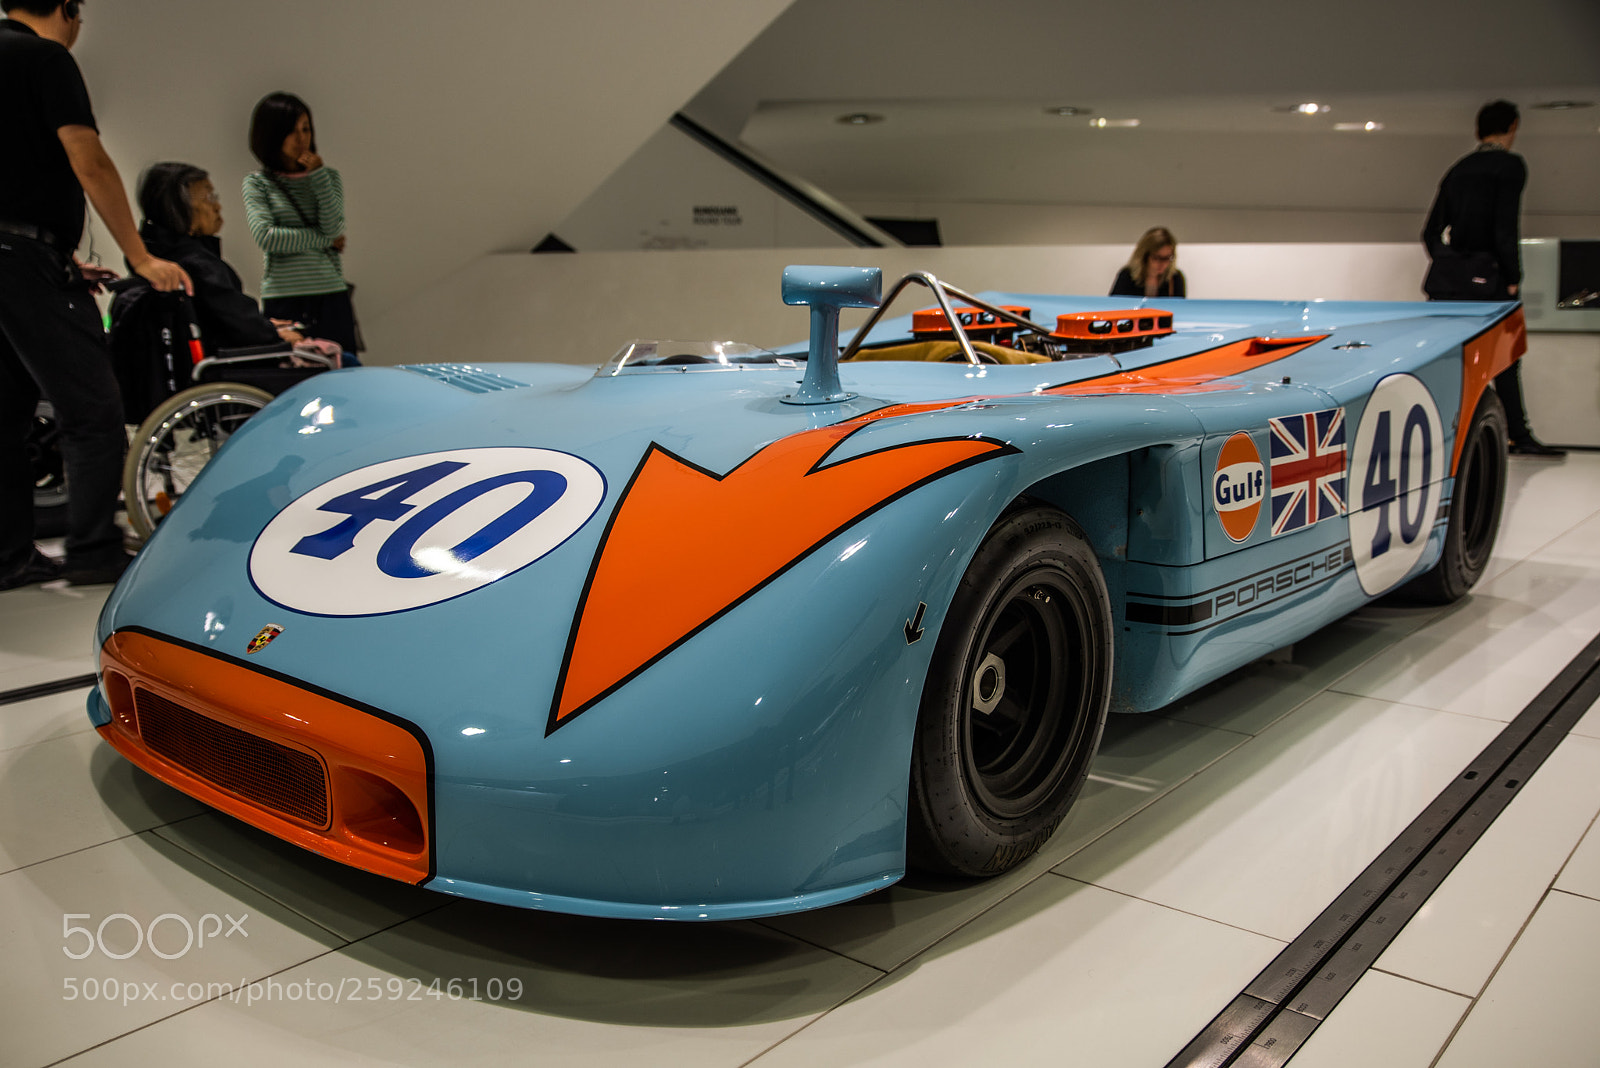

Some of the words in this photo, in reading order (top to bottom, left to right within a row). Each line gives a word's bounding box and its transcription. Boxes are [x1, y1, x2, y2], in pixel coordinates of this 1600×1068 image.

[289, 460, 567, 579] 40
[1215, 469, 1263, 506] Gulf
[1362, 403, 1432, 559] 40
[1215, 550, 1342, 616] PORSCHE
